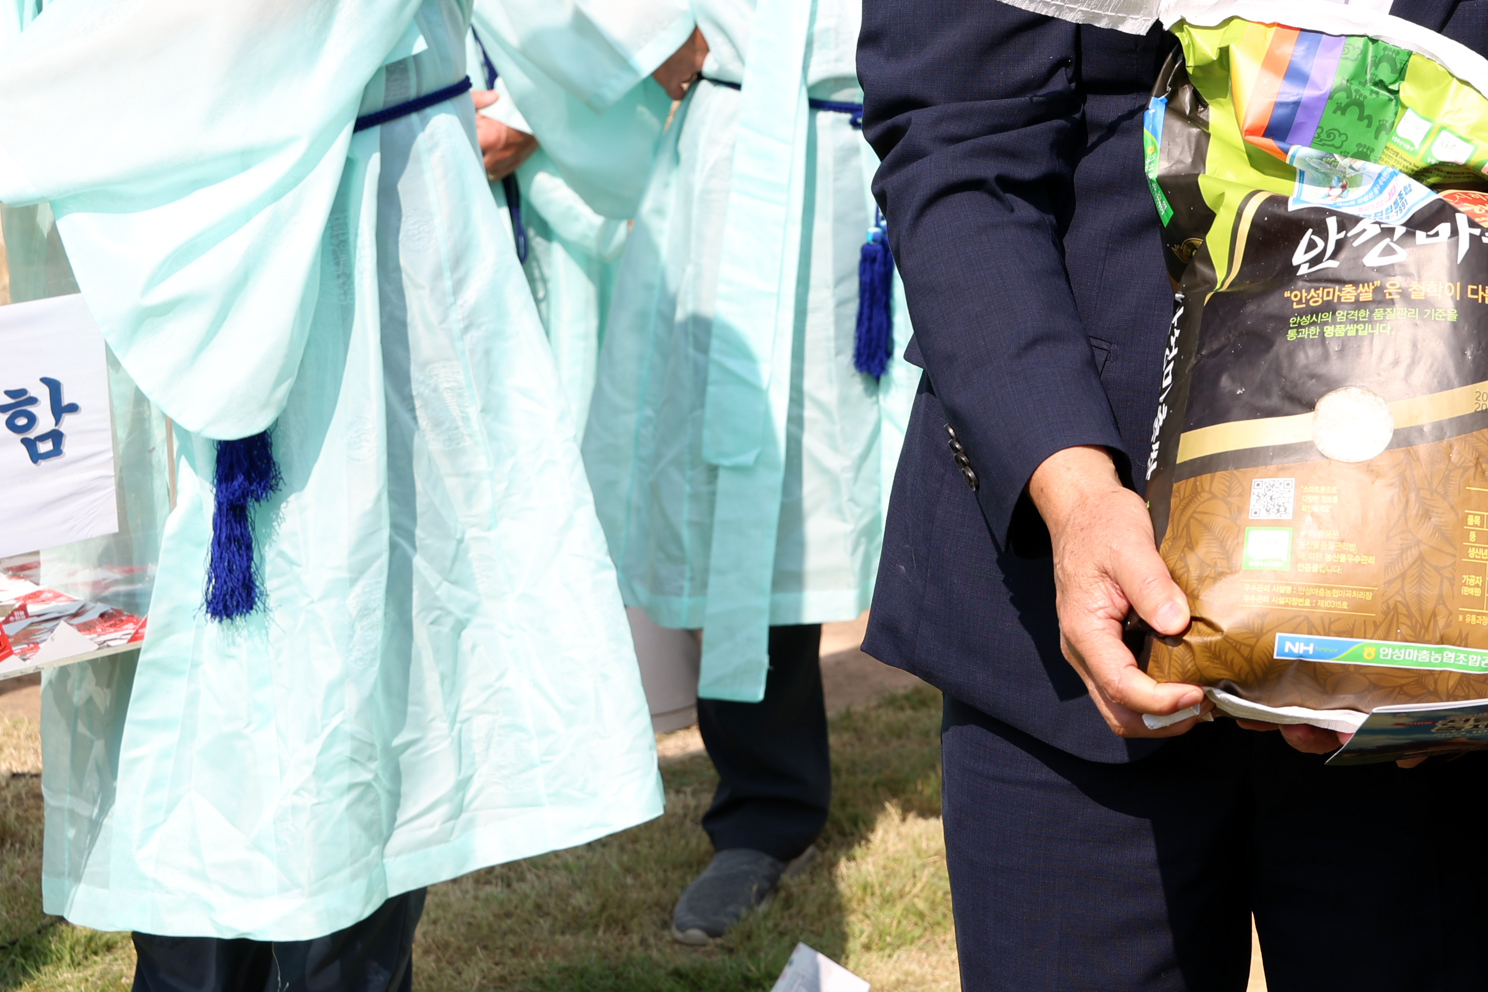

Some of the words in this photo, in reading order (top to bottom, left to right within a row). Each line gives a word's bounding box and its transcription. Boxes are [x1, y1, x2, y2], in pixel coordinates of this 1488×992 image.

[1283, 280, 1381, 310] “안성마춤쌀”
[1384, 281, 1402, 299] 은
[1408, 281, 1461, 300] 철학이
[1289, 311, 1332, 327] 안성시의
[1335, 309, 1370, 323] 엄격한
[1373, 308, 1419, 322] 품질관리
[1424, 308, 1458, 322] 기준을
[1286, 326, 1320, 341] 통과한
[1323, 322, 1395, 338] 명품쌀입니다.
[0, 376, 80, 466] 함
[1466, 514, 1481, 527] 품목
[1461, 574, 1482, 587] 가공자
[1284, 640, 1314, 655] NH
